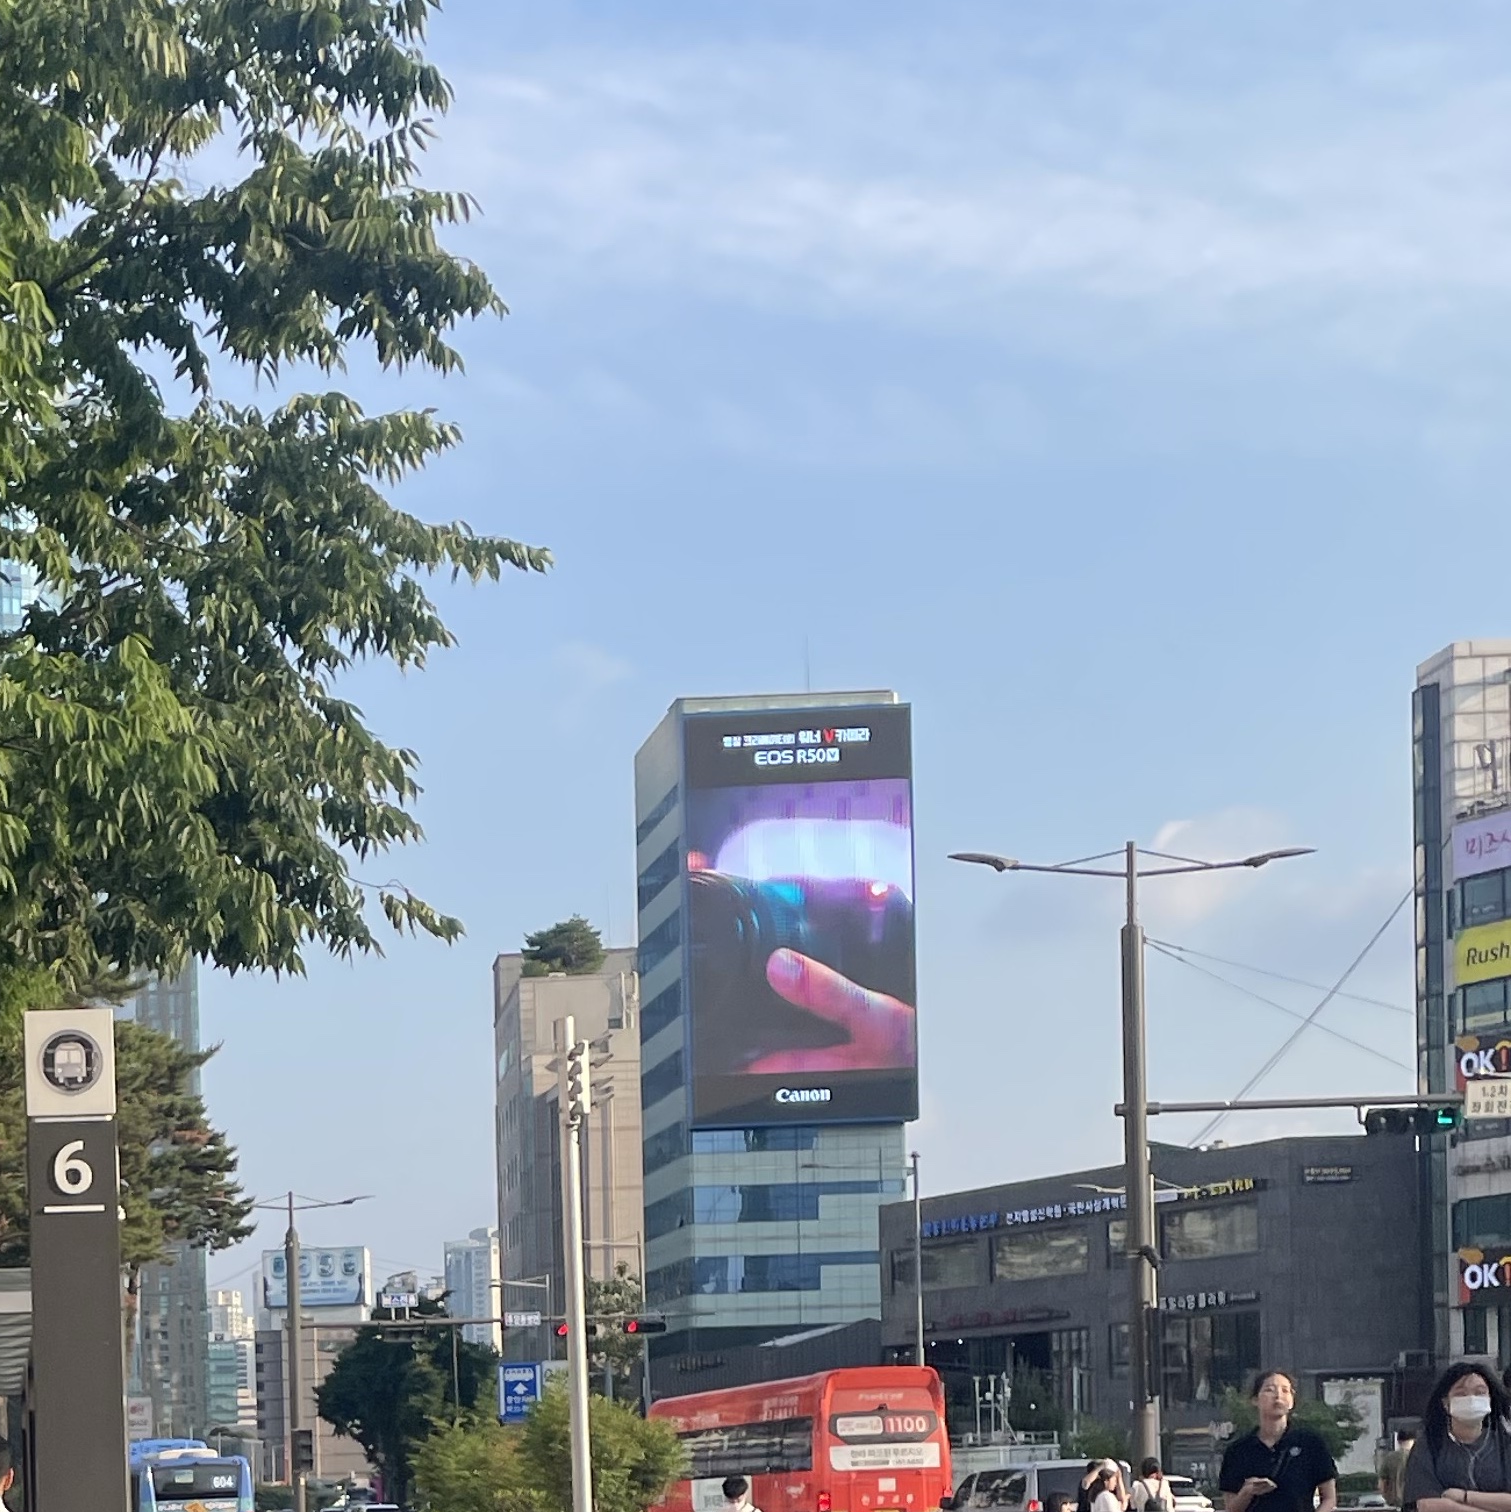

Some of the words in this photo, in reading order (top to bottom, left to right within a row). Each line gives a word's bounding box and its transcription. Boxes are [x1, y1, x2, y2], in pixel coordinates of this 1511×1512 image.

[754, 749, 794, 766] EOS
[775, 1086, 831, 1104] Canon
[54, 1139, 93, 1195] 6
[887, 1416, 927, 1433] 1100
[213, 1475, 235, 1489] 604
